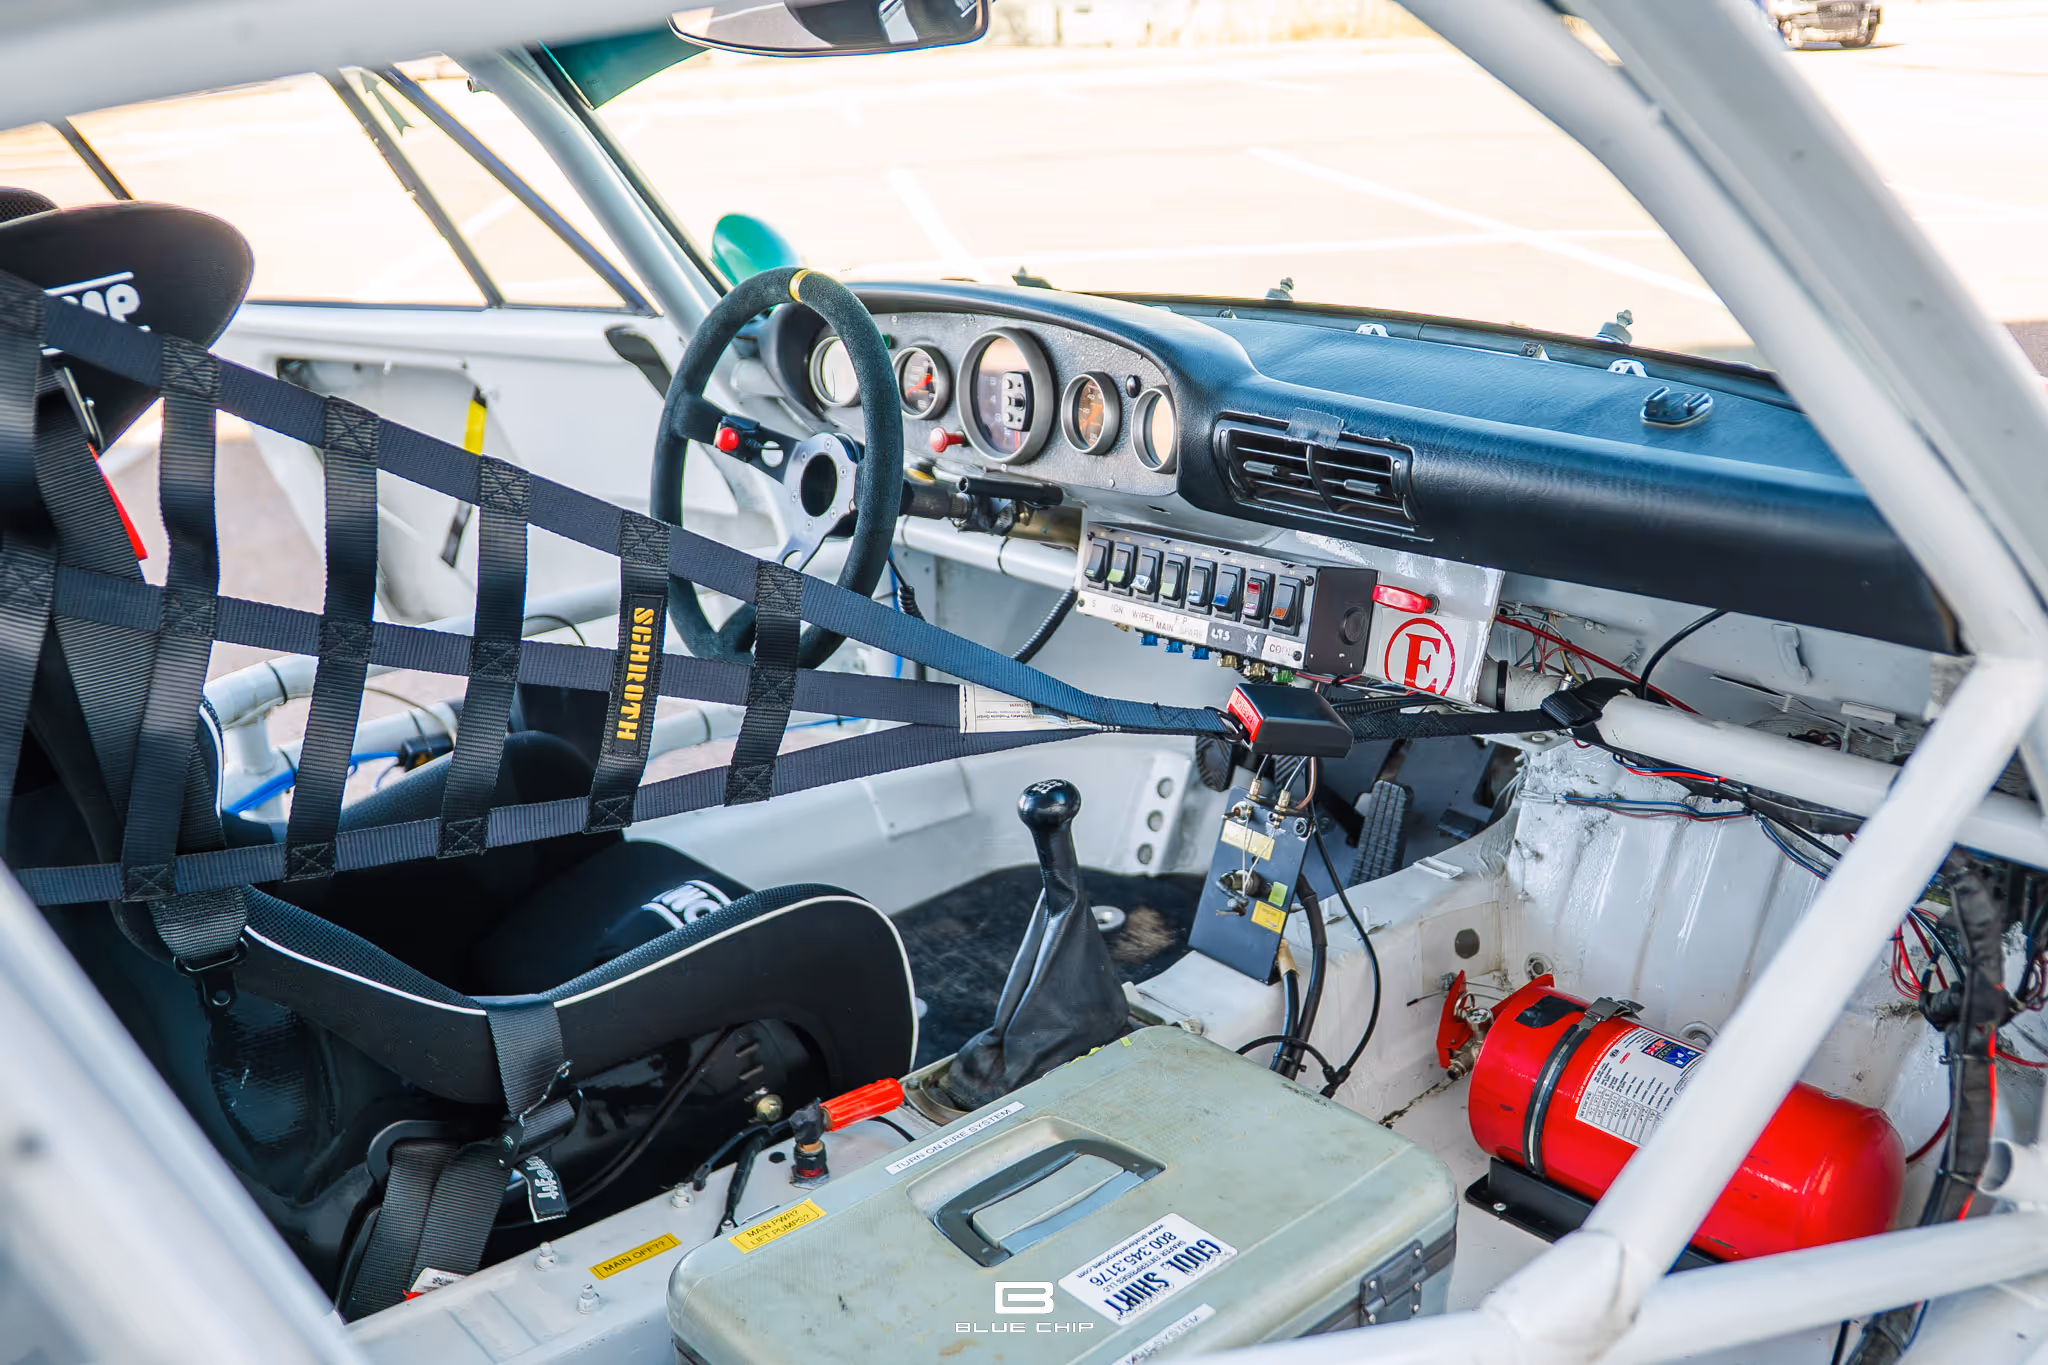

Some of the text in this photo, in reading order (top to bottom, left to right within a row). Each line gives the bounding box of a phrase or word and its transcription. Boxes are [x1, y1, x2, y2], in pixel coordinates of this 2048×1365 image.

[1110, 604, 1123, 615] IGN
[1132, 611, 1154, 624] WIPER
[1156, 621, 1174, 633] MAIN
[616, 608, 654, 740] SCHROTH
[1404, 633, 1441, 694] E
[894, 1109, 1012, 1170] TURN ON FIRE SYSTEM
[746, 1210, 799, 1238] MAIN PWR?
[750, 1213, 811, 1246] LIFT PUMPS?
[602, 1255, 632, 1273] MAIN
[1088, 1230, 1177, 1287] 800.345.3176
[1159, 1240, 1187, 1259] SHAFER
[1103, 1238, 1222, 1315] COOL SHIRT
[1117, 1252, 1160, 1284] ENTERPRISES
